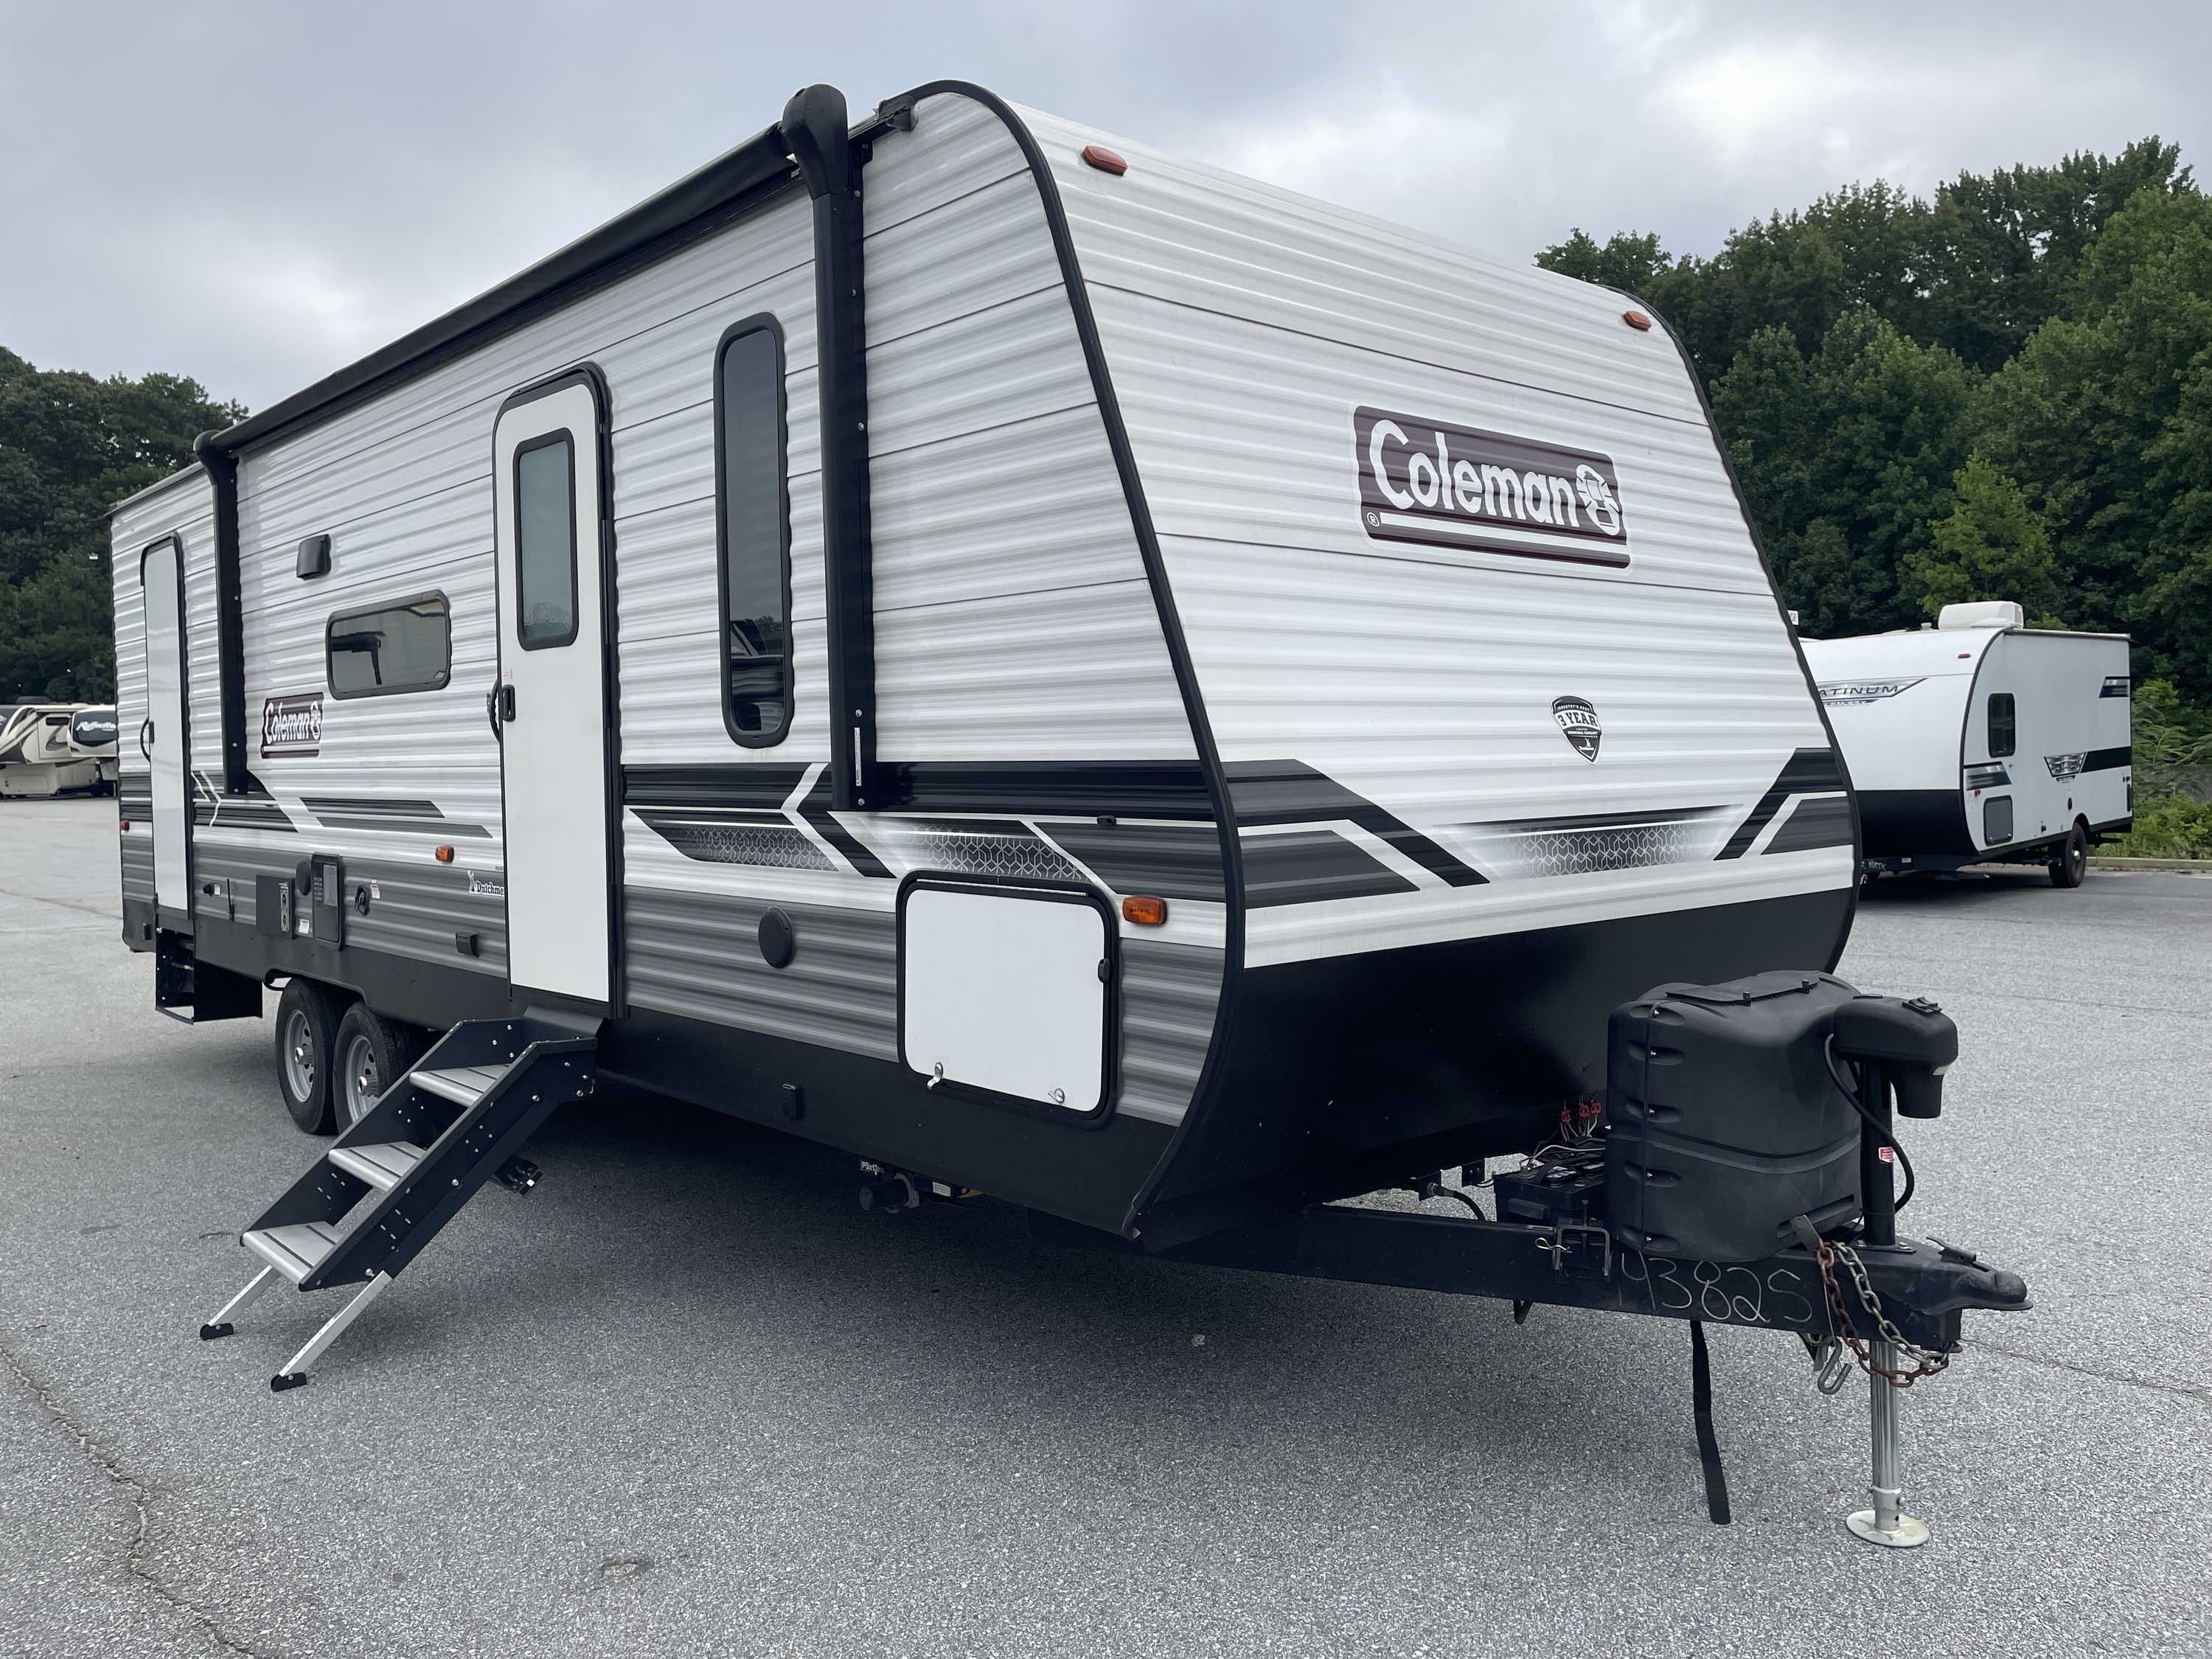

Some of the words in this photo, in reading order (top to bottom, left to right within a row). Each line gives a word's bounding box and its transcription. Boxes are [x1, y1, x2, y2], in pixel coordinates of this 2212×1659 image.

[1369, 419, 1580, 527] Coleman
[1819, 685, 1899, 696] ATINUM
[264, 702, 310, 745] Coleman
[1557, 714, 1568, 727] 3
[1565, 712, 1599, 728] YEAR
[476, 881, 504, 895] Dutchme
